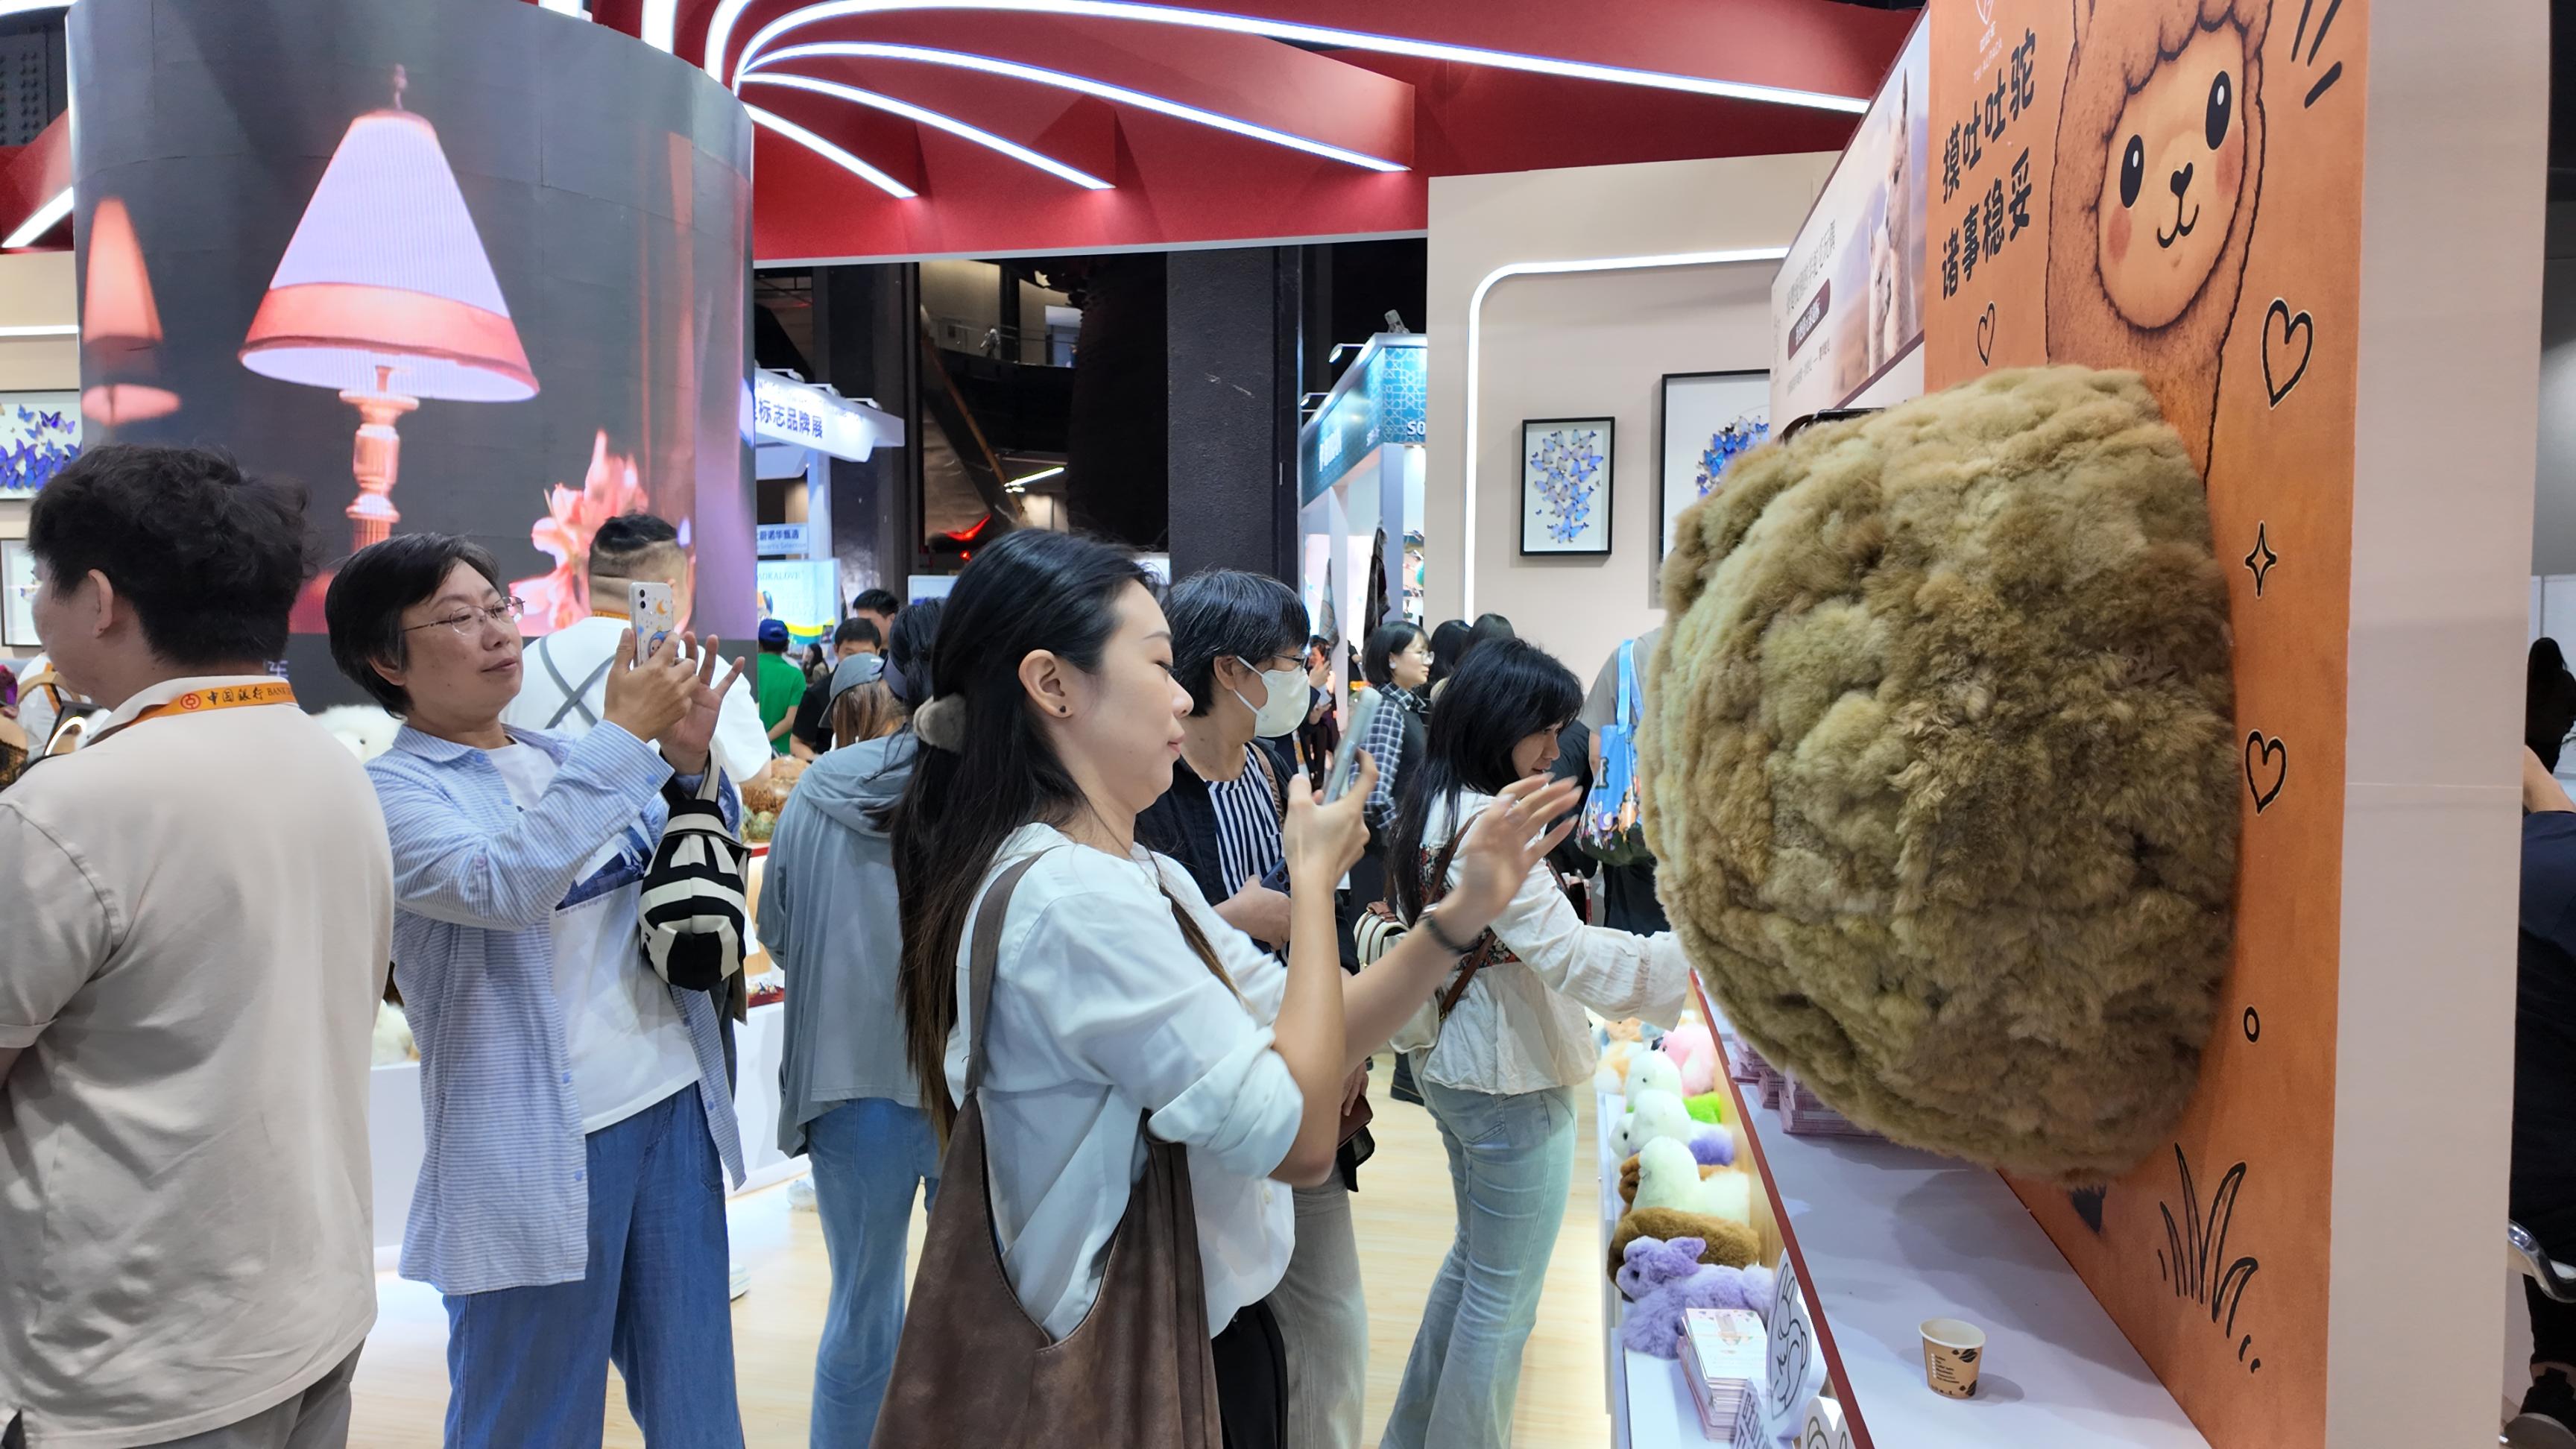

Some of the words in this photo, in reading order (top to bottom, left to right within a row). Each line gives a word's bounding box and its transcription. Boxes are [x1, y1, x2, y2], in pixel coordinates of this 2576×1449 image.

[1942, 27, 2036, 204] 摸吐吐驼
[1942, 146, 2033, 300] 诸事稳妥
[755, 397, 824, 438] 标志品牌展
